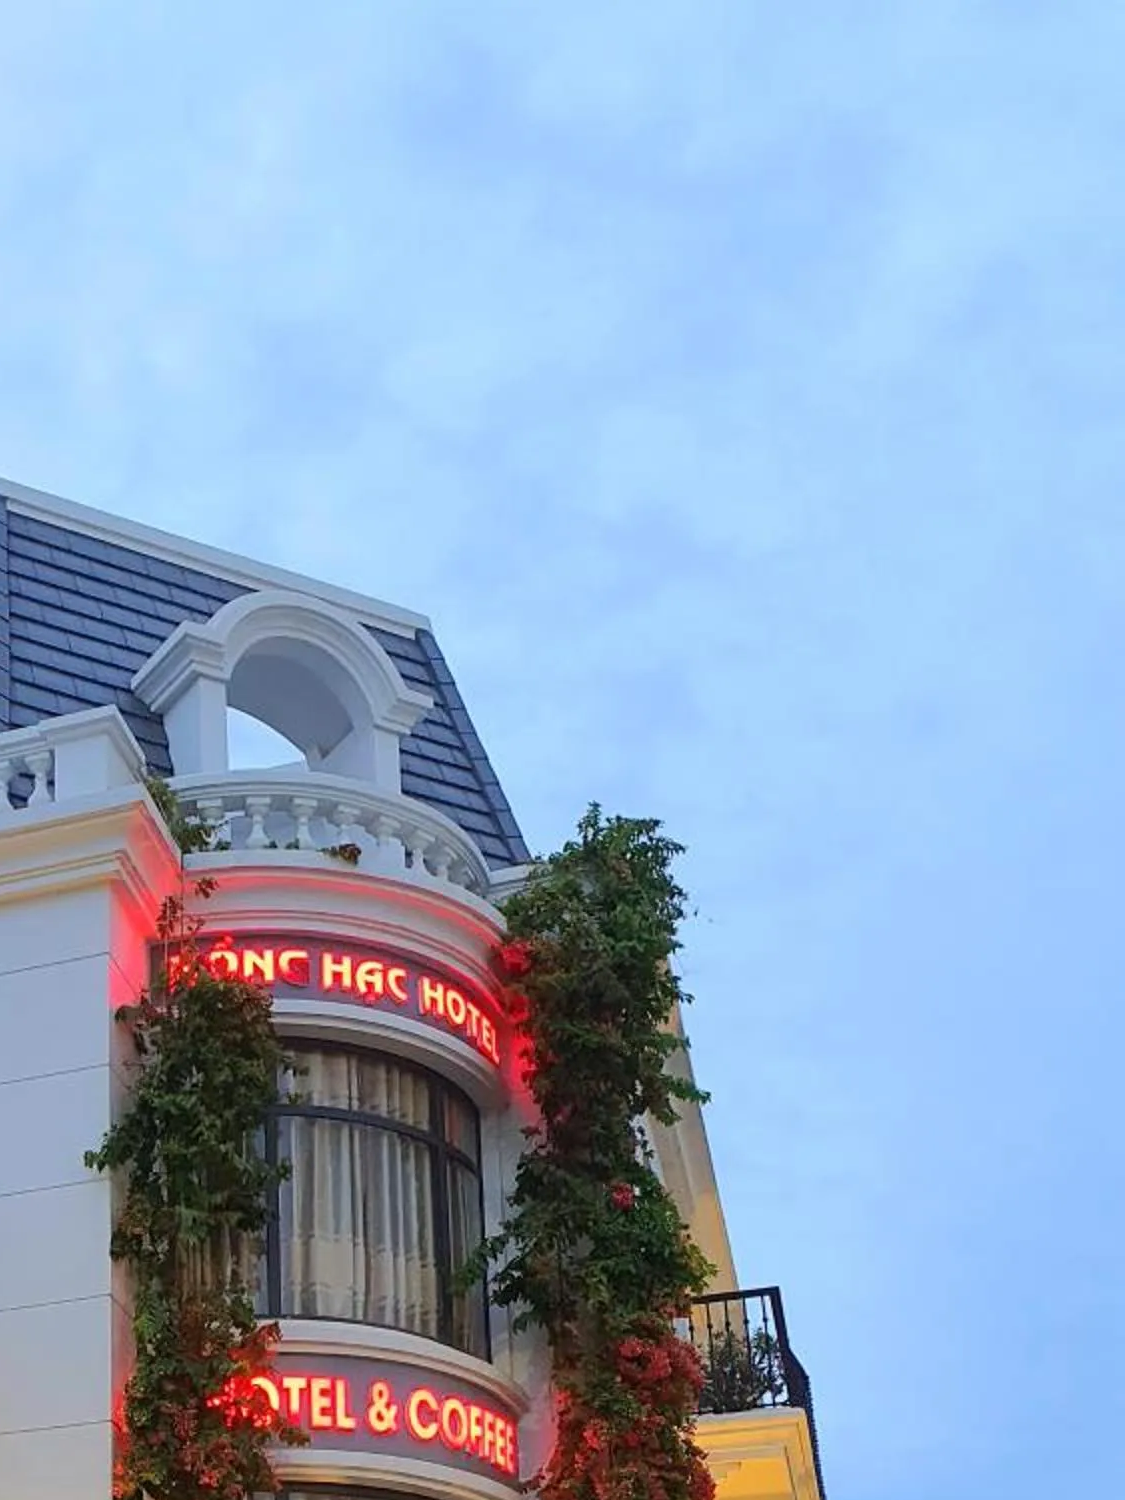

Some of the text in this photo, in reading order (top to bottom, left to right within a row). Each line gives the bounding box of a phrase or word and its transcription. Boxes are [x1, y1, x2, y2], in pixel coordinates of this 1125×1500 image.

[418, 975, 502, 1066] HOTEL
[367, 1380, 399, 1433] &
[406, 1387, 516, 1475] COFFEE
